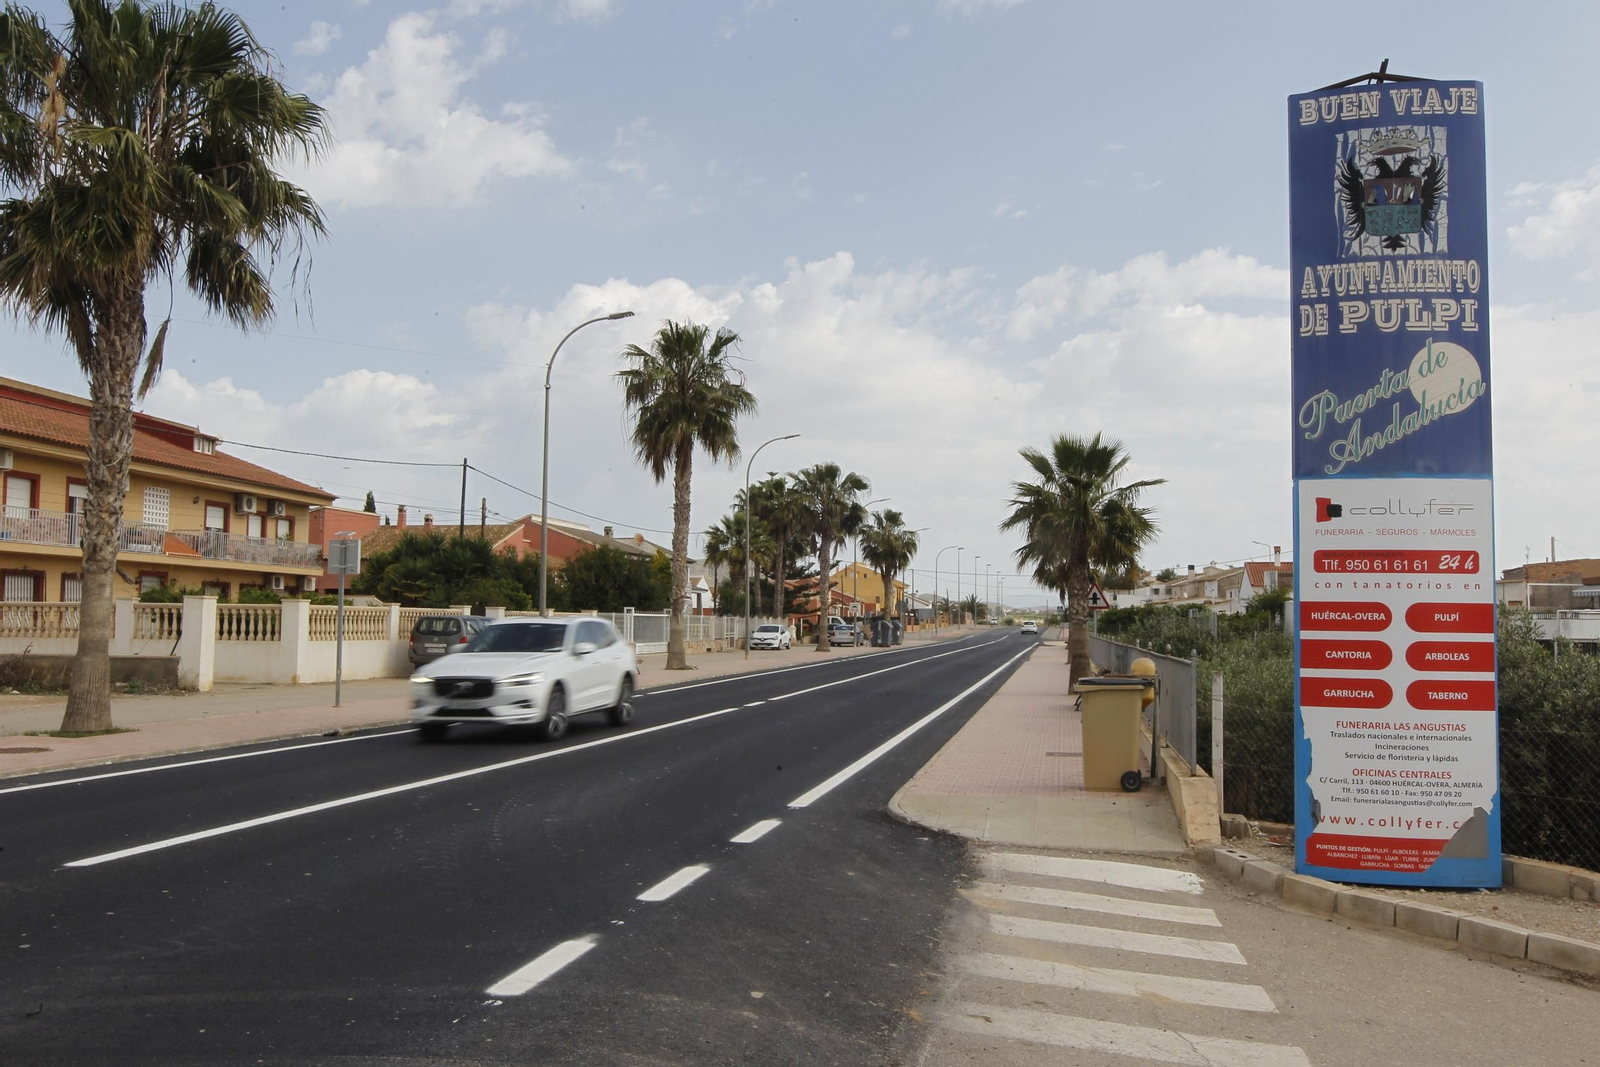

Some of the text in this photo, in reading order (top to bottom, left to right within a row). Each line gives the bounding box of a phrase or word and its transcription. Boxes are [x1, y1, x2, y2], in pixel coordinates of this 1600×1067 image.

[1300, 88, 1477, 125] BUEN VIAJE
[1301, 260, 1480, 298] AYUNTAMIENTO
[1300, 299, 1478, 336] DE PULPI
[1299, 338, 1448, 440] Puerta de
[1325, 378, 1486, 474] Andalucía
[1350, 498, 1474, 518] collyfer
[1430, 528, 1476, 536] MÁRMOLES
[1322, 554, 1474, 571] Tlf. 950 61 61 61 24 h
[1354, 581, 1451, 590] tanatorios
[1311, 611, 1385, 620] HUÉRCAL-OVERA
[1435, 612, 1459, 621] PULPÍ
[1326, 651, 1371, 659] CANTORIA
[1425, 652, 1469, 660] ARBOLEAS
[1324, 689, 1374, 698] GARRUCHA
[1428, 692, 1468, 700] TABERNO
[1336, 721, 1390, 730] FUNERARIA
[1413, 723, 1466, 731] ANGUSTIAS
[1330, 731, 1365, 739] Traslados
[1367, 732, 1407, 740] nacionales
[1416, 734, 1472, 742] internacionales
[1375, 743, 1429, 751] Incineraciones
[1345, 752, 1374, 760] Servicio
[1432, 755, 1458, 763] lápidas
[1352, 768, 1452, 779] OFICINAS CENTRALES
[1329, 777, 1350, 785] Carril,
[1353, 796, 1472, 808] funerarialasangustias@collyfer.com
[1319, 815, 1464, 830] www.collyfer.c
